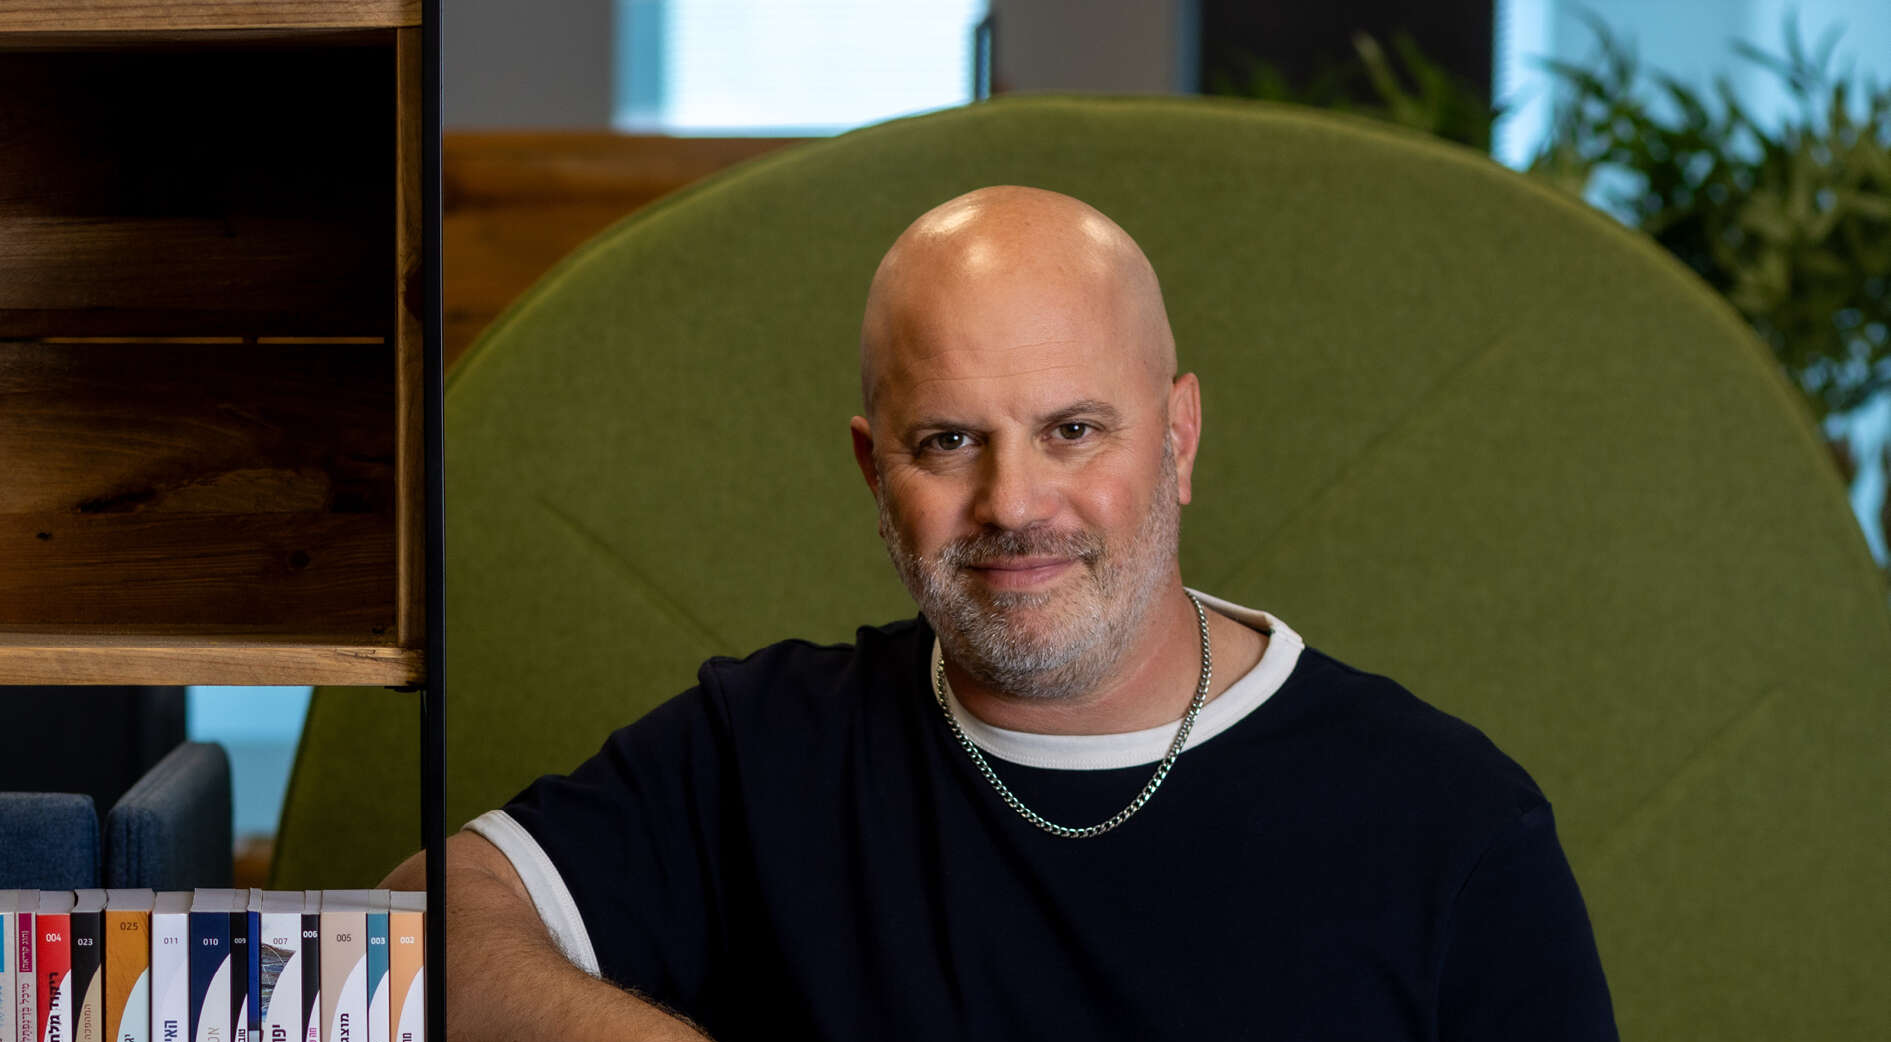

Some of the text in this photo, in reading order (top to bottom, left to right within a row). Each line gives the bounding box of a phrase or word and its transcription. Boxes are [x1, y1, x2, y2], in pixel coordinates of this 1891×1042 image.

[120, 921, 139, 931] 025
[46, 933, 62, 942] 004
[78, 938, 93, 946] 023
[164, 937, 178, 945] 011
[203, 938, 218, 946] 010
[273, 937, 288, 945] 007
[336, 934, 351, 942] 005
[48, 972, 61, 1010] ריקוד
[340, 1013, 350, 1042] מוצג
[237, 1028, 245, 1042] טוב
[309, 1027, 317, 1038] מה
